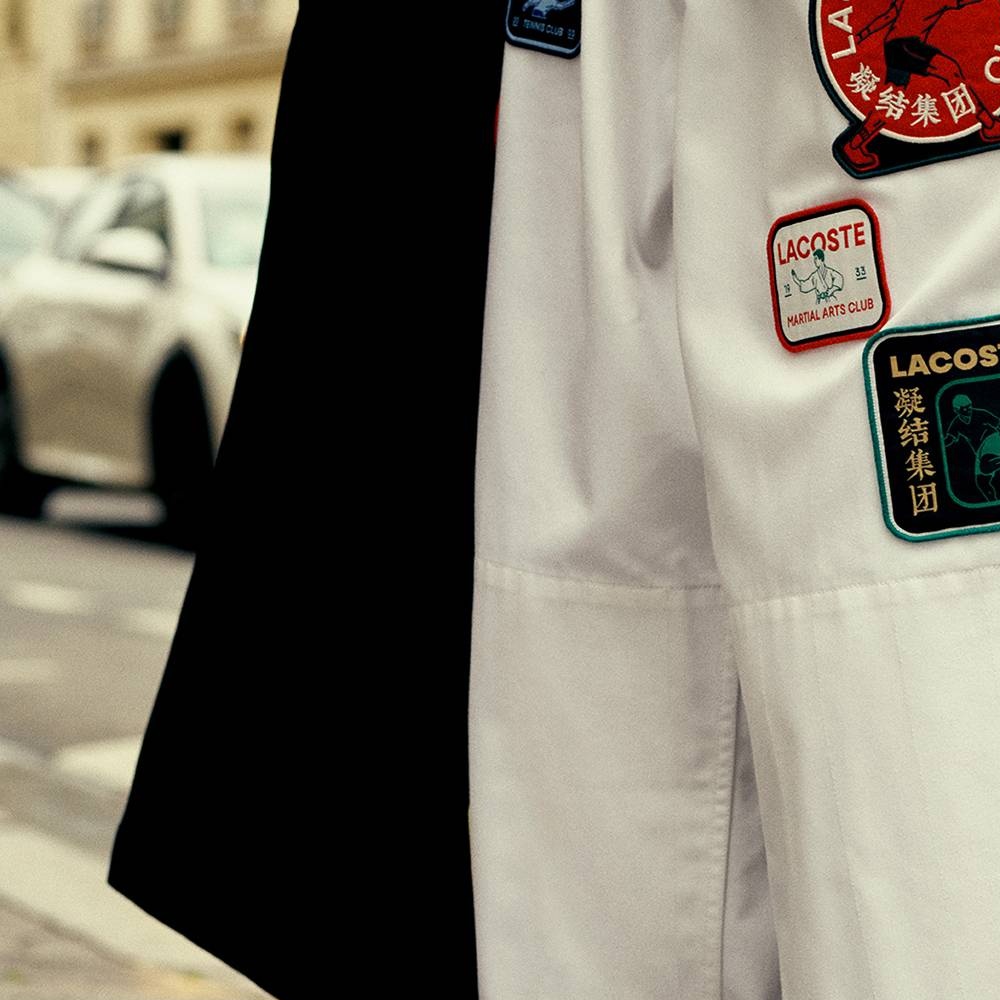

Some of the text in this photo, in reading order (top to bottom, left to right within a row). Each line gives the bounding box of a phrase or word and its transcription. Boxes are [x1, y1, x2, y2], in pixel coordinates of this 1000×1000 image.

[546, 25, 564, 36] CLUB
[777, 222, 866, 265] LACOSTE
[787, 298, 874, 328] MARTIAL ARTS CLUB
[893, 387, 938, 516] 凝结集团
